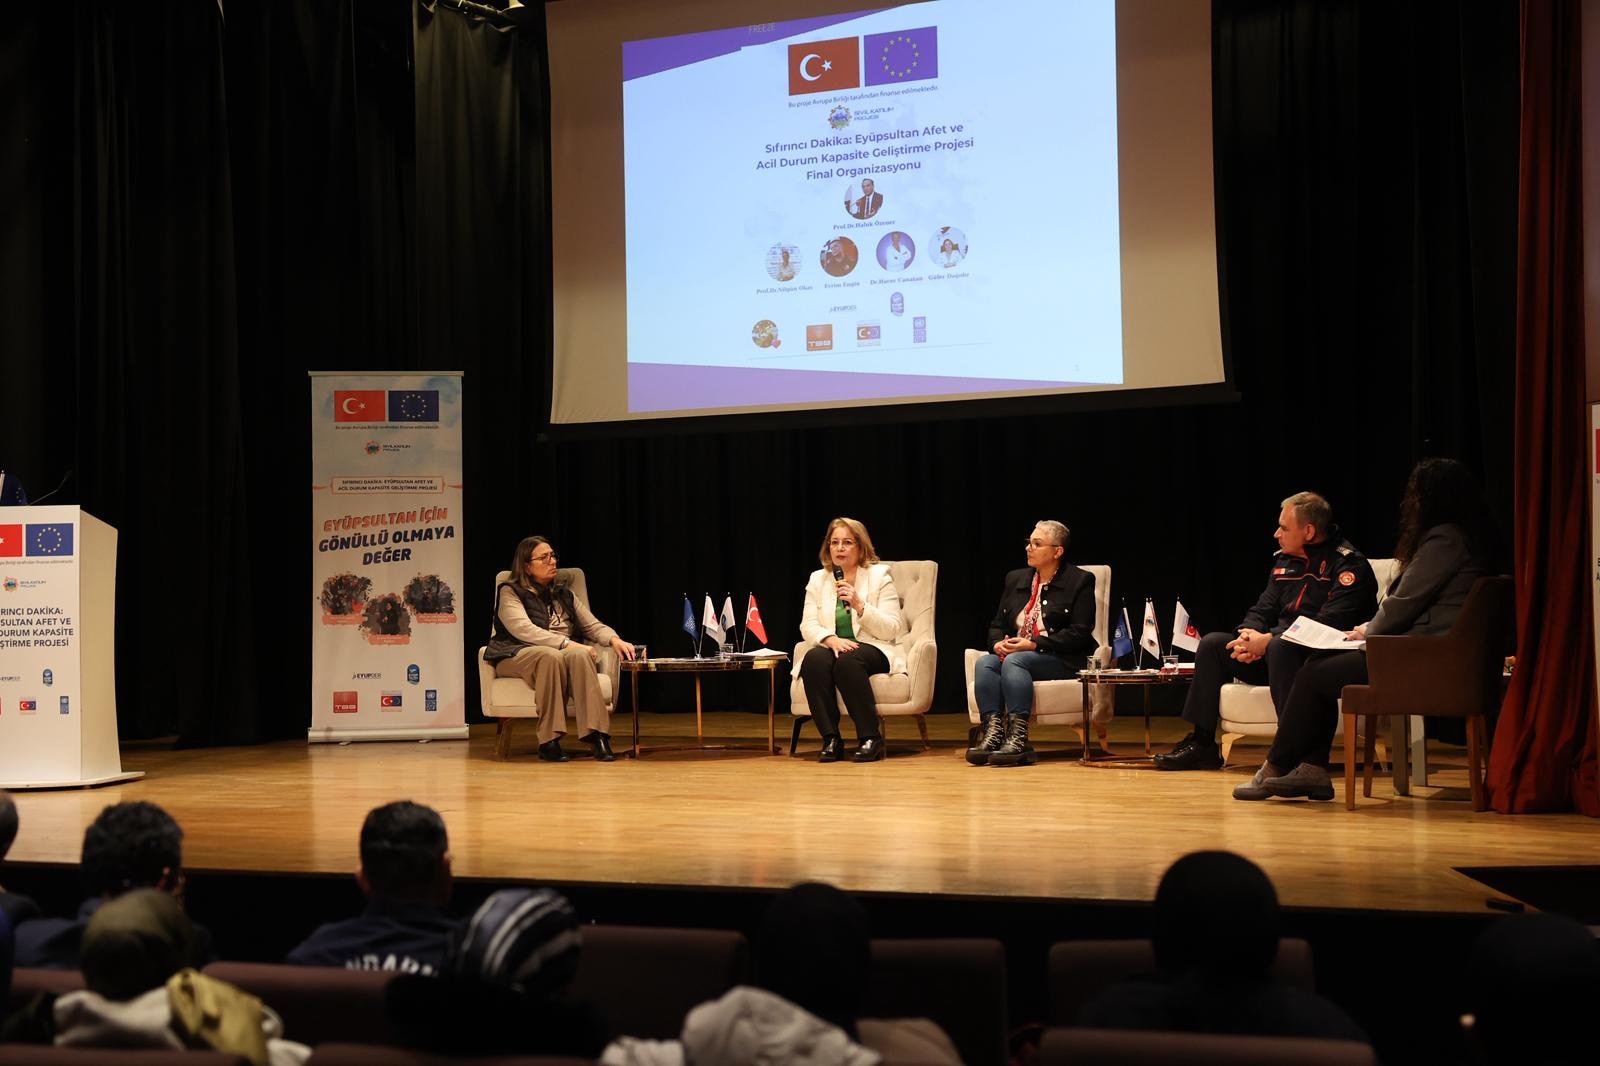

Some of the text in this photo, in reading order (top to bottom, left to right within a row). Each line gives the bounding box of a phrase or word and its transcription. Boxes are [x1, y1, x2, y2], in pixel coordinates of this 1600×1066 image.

[749, 23, 777, 33] FREEZE
[765, 124, 964, 153] Sıfırıncı Dakika: Eyüpsultan Afet ve
[756, 136, 974, 171] Acil Durum Kapasite Geliştirme Projesi
[807, 161, 921, 181] Final Organizasyonu
[323, 506, 448, 533] EYÜPSULTAN İÇİN
[319, 525, 454, 552] GÖNÜLLÜ OLMAYA
[362, 547, 412, 565] DEĞER
[0, 605, 64, 616] RINCI DAKİKA:
[0, 617, 72, 626] SULTAN AFET VE
[32, 627, 74, 637] KAPASİTE
[33, 637, 70, 647] PROJESİ
